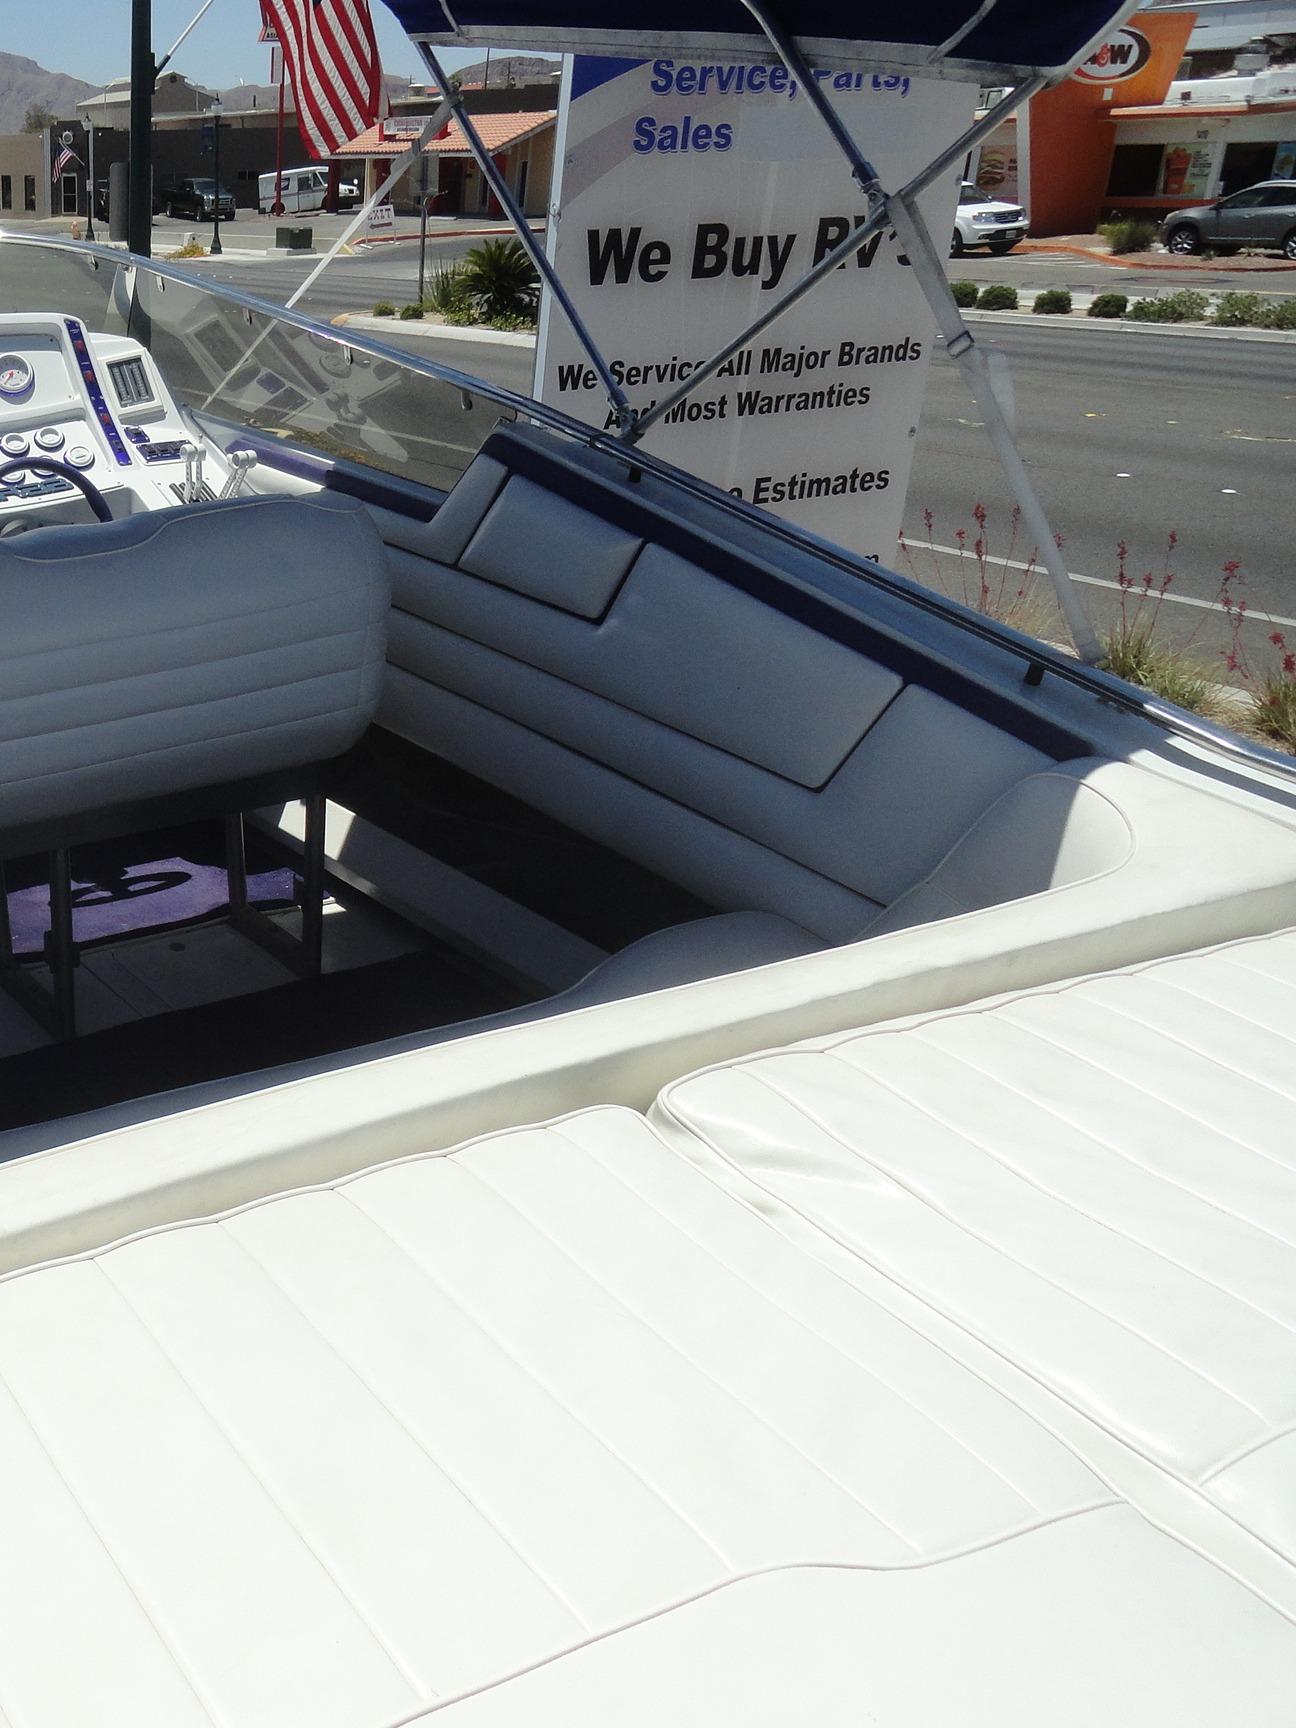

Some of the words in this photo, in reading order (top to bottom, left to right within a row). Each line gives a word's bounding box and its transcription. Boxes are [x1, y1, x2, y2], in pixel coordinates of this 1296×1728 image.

[650, 59, 798, 98] Service,
[814, 69, 911, 98] arts,
[632, 115, 733, 154] Sales
[587, 227, 671, 285] We
[691, 223, 797, 290] Buy
[813, 215, 912, 270] RV'
[558, 363, 598, 391] We
[717, 350, 752, 378] All
[759, 347, 831, 378] Major
[838, 337, 922, 367] Brands
[664, 396, 728, 424] Most
[736, 384, 871, 416] Warranties
[753, 467, 890, 505] Estimates
